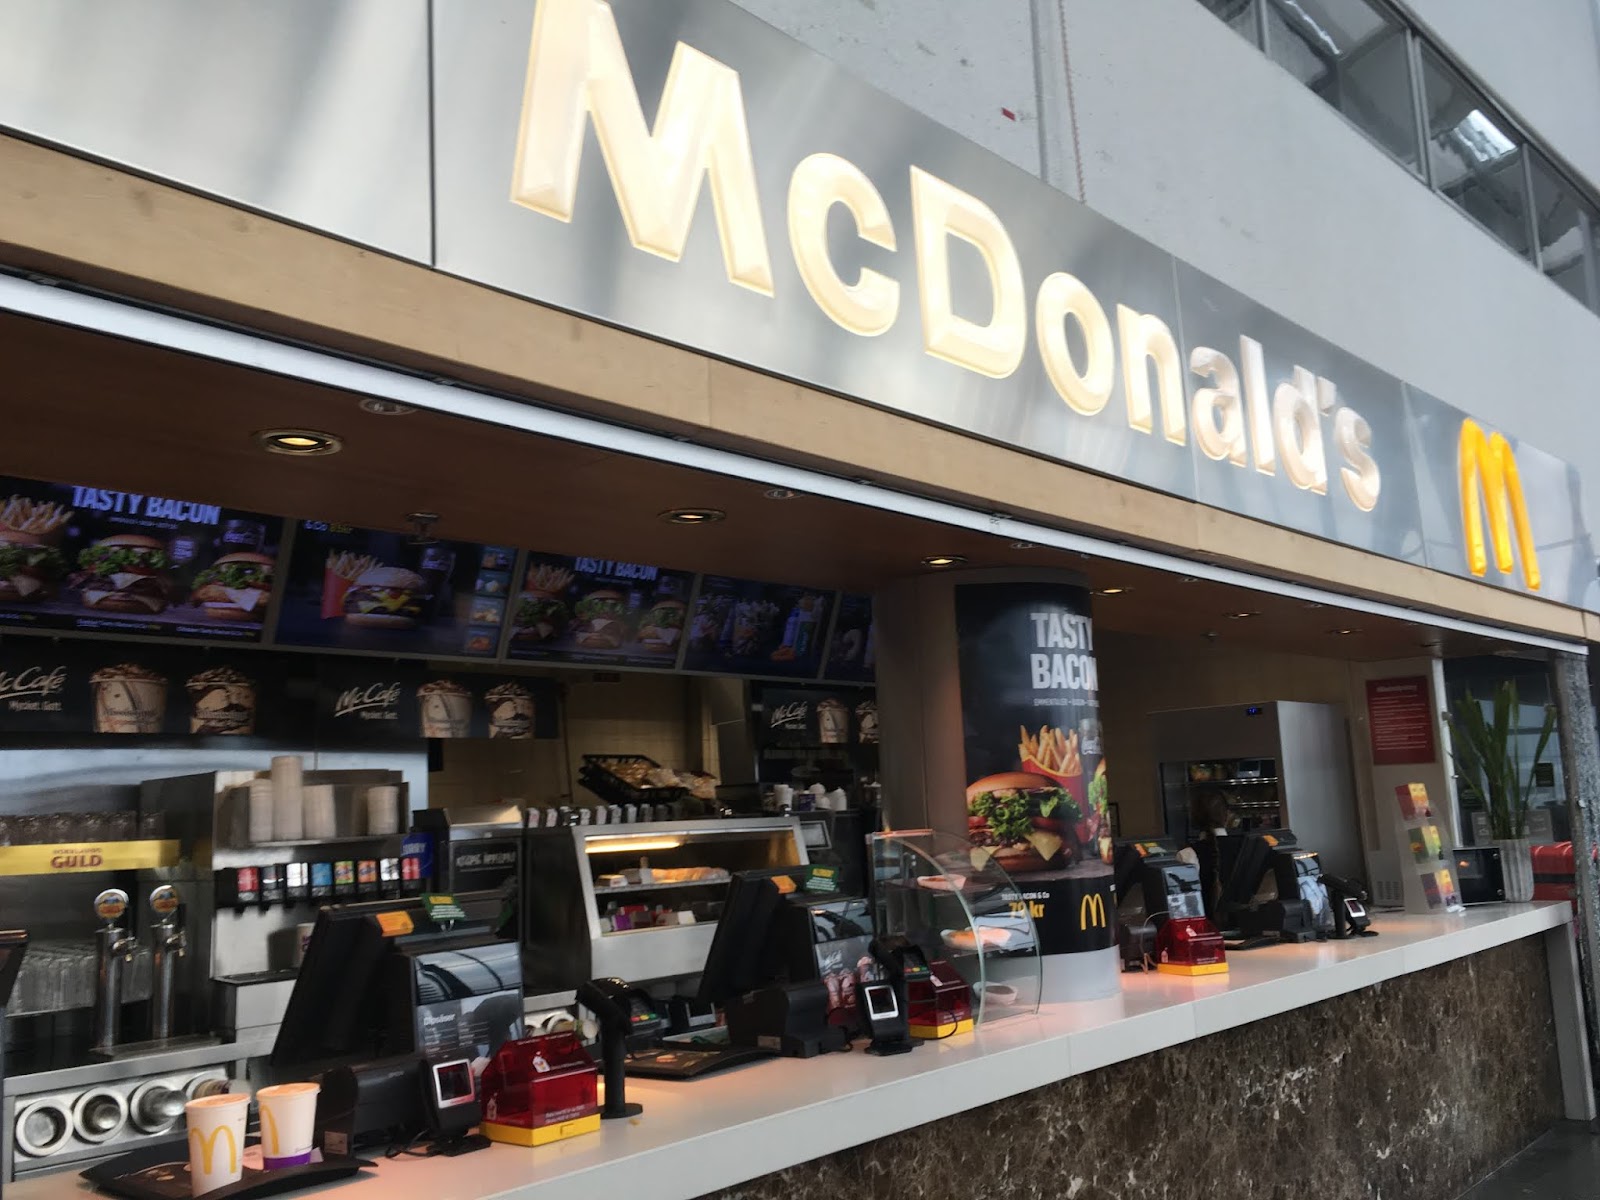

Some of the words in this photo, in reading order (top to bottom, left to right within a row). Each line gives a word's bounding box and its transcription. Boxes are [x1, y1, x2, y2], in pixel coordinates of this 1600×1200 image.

[510, 0, 1381, 512] McDonald's
[72, 485, 144, 515] TASTY
[145, 496, 222, 526] BACON
[574, 556, 614, 576] TASTY
[1030, 612, 1094, 651] TASTY
[1030, 653, 1099, 691] BACON
[335, 681, 402, 713] McCafé
[51, 855, 103, 868] GULD
[1029, 900, 1045, 919] kr
